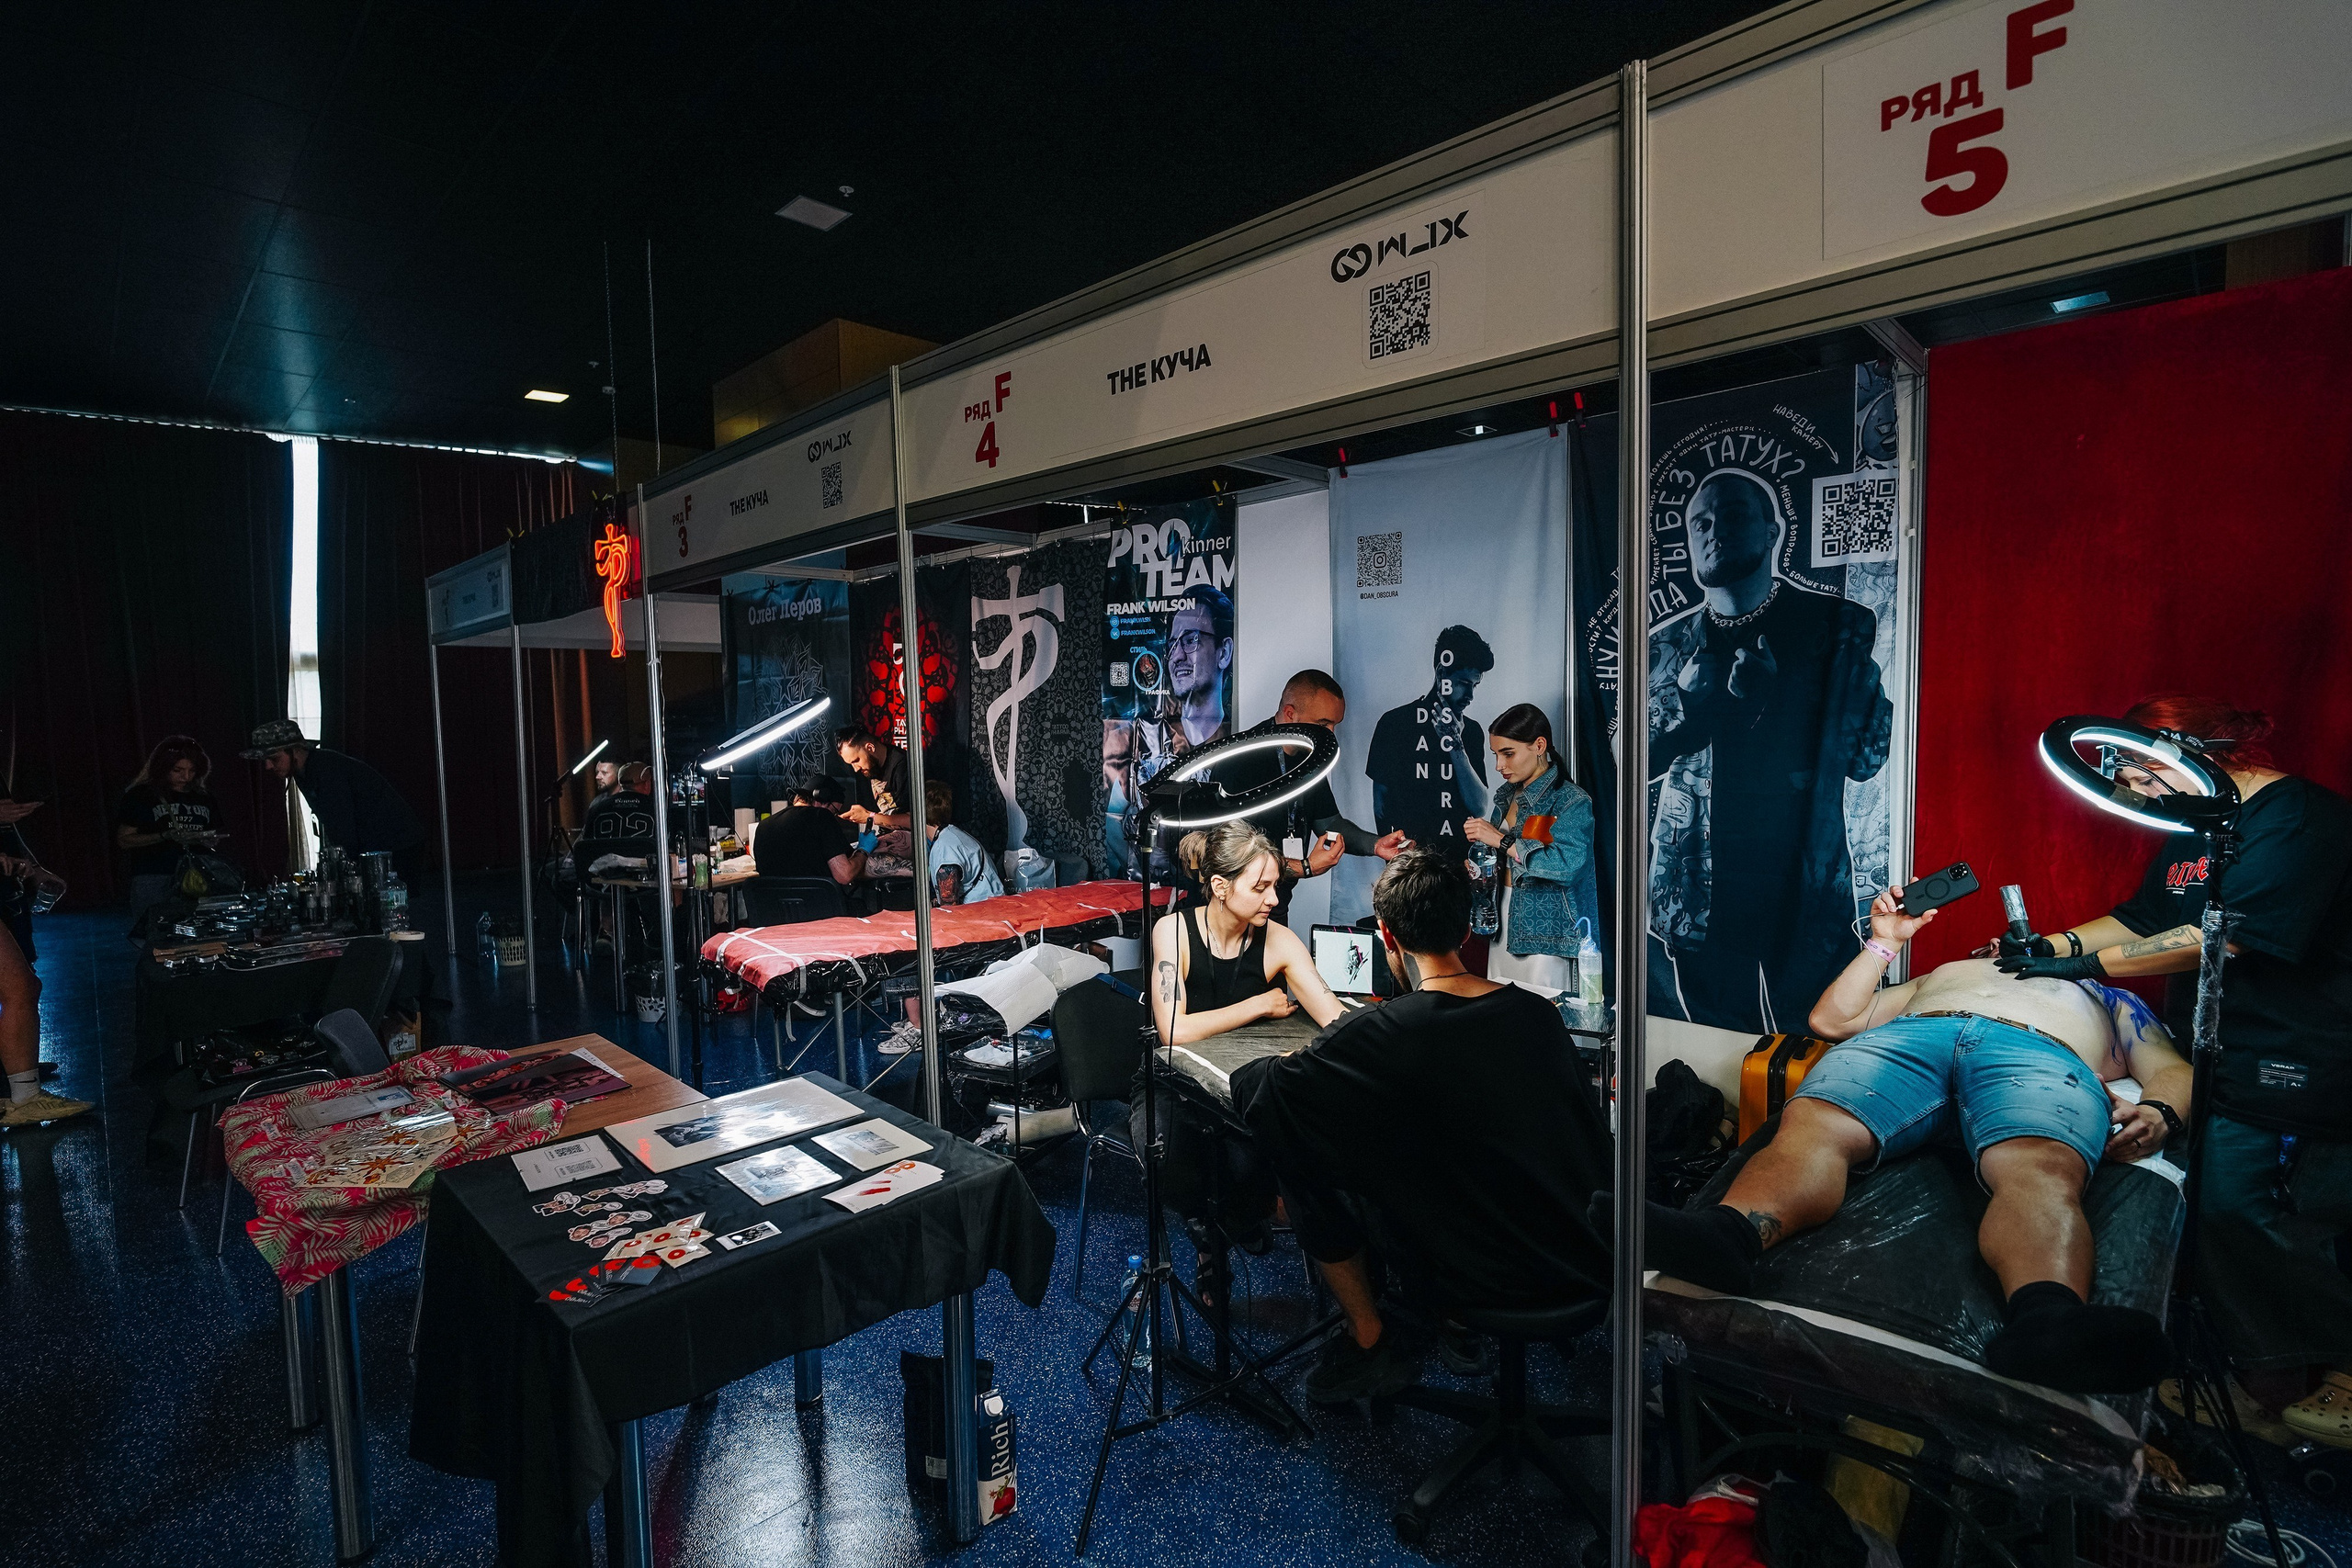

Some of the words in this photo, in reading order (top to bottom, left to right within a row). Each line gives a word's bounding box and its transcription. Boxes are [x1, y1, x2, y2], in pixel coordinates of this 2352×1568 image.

[1881, 69, 1984, 131] РЯД
[2007, 0, 2075, 90] F
[1920, 107, 2008, 217] 5
[1107, 365, 1147, 395] THE
[1150, 343, 1212, 383] КУЧА
[965, 400, 991, 423] РЯД
[995, 371, 1012, 413] F
[1772, 403, 1817, 434] НАВЕДИ
[975, 422, 1000, 468] 4
[1679, 443, 1699, 458] ОДИН
[1700, 434, 1806, 482] ТАТУХ?
[1791, 426, 1825, 450] КАМЕРУ
[673, 512, 685, 525] РЯД
[684, 494, 692, 521] F
[729, 498, 746, 516] THE
[746, 490, 769, 511] КУЧА
[1655, 468, 1696, 532] БЕЗ
[678, 525, 688, 558] 3
[1107, 518, 1193, 569] PRO
[1779, 484, 1798, 521] МЕНЬШЕ
[1789, 570, 1820, 590] БОЛЬШЕ
[1661, 542, 1689, 581] ТЫ
[749, 604, 776, 626] Олег
[780, 597, 822, 620] Перов
[1106, 601, 1146, 615] FRANK
[1146, 597, 1196, 614] WILSON
[1415, 707, 1430, 780] DAN
[1439, 649, 1454, 837] OBSCURA
[990, 1419, 1011, 1478] Rich
